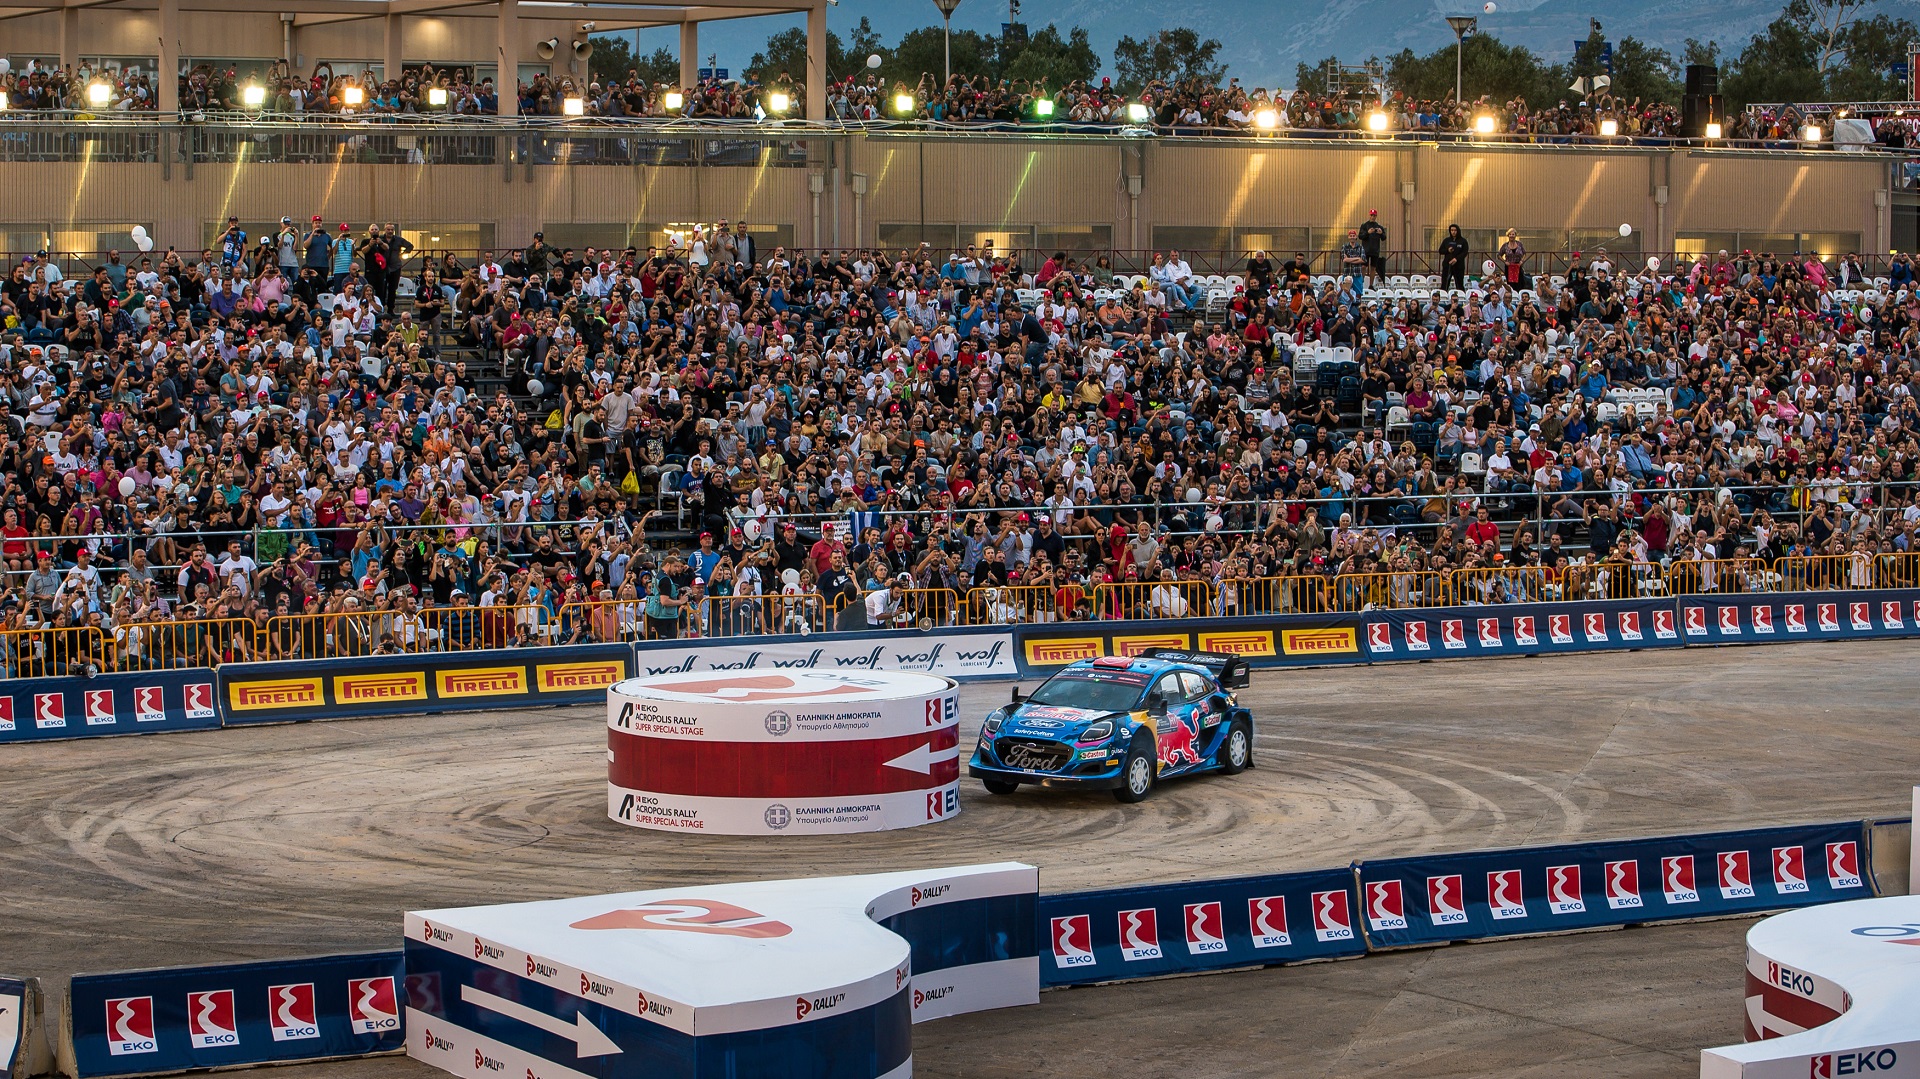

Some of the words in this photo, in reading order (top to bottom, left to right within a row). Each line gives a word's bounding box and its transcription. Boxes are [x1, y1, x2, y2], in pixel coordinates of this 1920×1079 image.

[1206, 636, 1267, 653] PIRELLI
[1289, 633, 1349, 650] PIRELLI
[895, 643, 946, 671] wolf
[955, 640, 1006, 668] wolf
[1033, 643, 1097, 661] PIRELLI
[709, 652, 762, 670] wolf
[772, 649, 823, 668] wolf
[834, 646, 885, 669] wolf
[646, 655, 699, 675] wolf
[547, 666, 617, 687] PIRELLI
[445, 672, 518, 693] PIRELLI
[343, 677, 418, 699] PIRELLI
[239, 683, 316, 705] PIRELLI
[641, 704, 658, 712] EKO
[944, 694, 960, 720] EK
[635, 713, 672, 724] ACROPOLIS
[673, 716, 698, 725] RALLY
[836, 712, 881, 720] ΔΗΜΟΚΡΑΤΙΑ
[635, 722, 652, 731] SUPER
[653, 724, 679, 734] SPECIAL
[680, 727, 704, 735] STAGE
[796, 723, 832, 731] Υπουργείο
[1014, 729, 1055, 737] SafetyCulture
[1005, 745, 1059, 771] Ford
[642, 797, 659, 805] EKO
[945, 785, 960, 812] EK
[635, 805, 672, 816] ACROPOLIS
[673, 809, 698, 818] RALLY
[795, 807, 834, 815] ΕΛΛΗΝΙΚΗ
[836, 805, 881, 813] ΔΗΜΟΚΡΑΤΙΑ
[635, 814, 652, 824] SUPER
[653, 817, 679, 826] SPECIAL
[680, 820, 704, 828] STAGE
[795, 816, 831, 825] Υπουργείο
[1838, 877, 1859, 886] EKO
[1730, 887, 1751, 896] EKO
[1785, 883, 1806, 891] EKO
[1617, 897, 1640, 906] EKO
[1674, 893, 1696, 901] EKO
[1501, 907, 1524, 916] EKO
[1560, 902, 1583, 911] EKO
[1441, 913, 1465, 922] EKO
[1380, 919, 1404, 927] EKO
[1326, 928, 1351, 938] EKO
[1263, 935, 1288, 944] EKO
[1199, 942, 1224, 951] EKO
[1133, 948, 1158, 957] EKO
[1066, 955, 1092, 965] EKO
[1781, 967, 1815, 996] EKO
[365, 1018, 396, 1029] EKO
[286, 1027, 316, 1037] EKO
[204, 1034, 235, 1044] EKO
[122, 1041, 154, 1051] EKO
[1837, 1048, 1897, 1076] EKO
